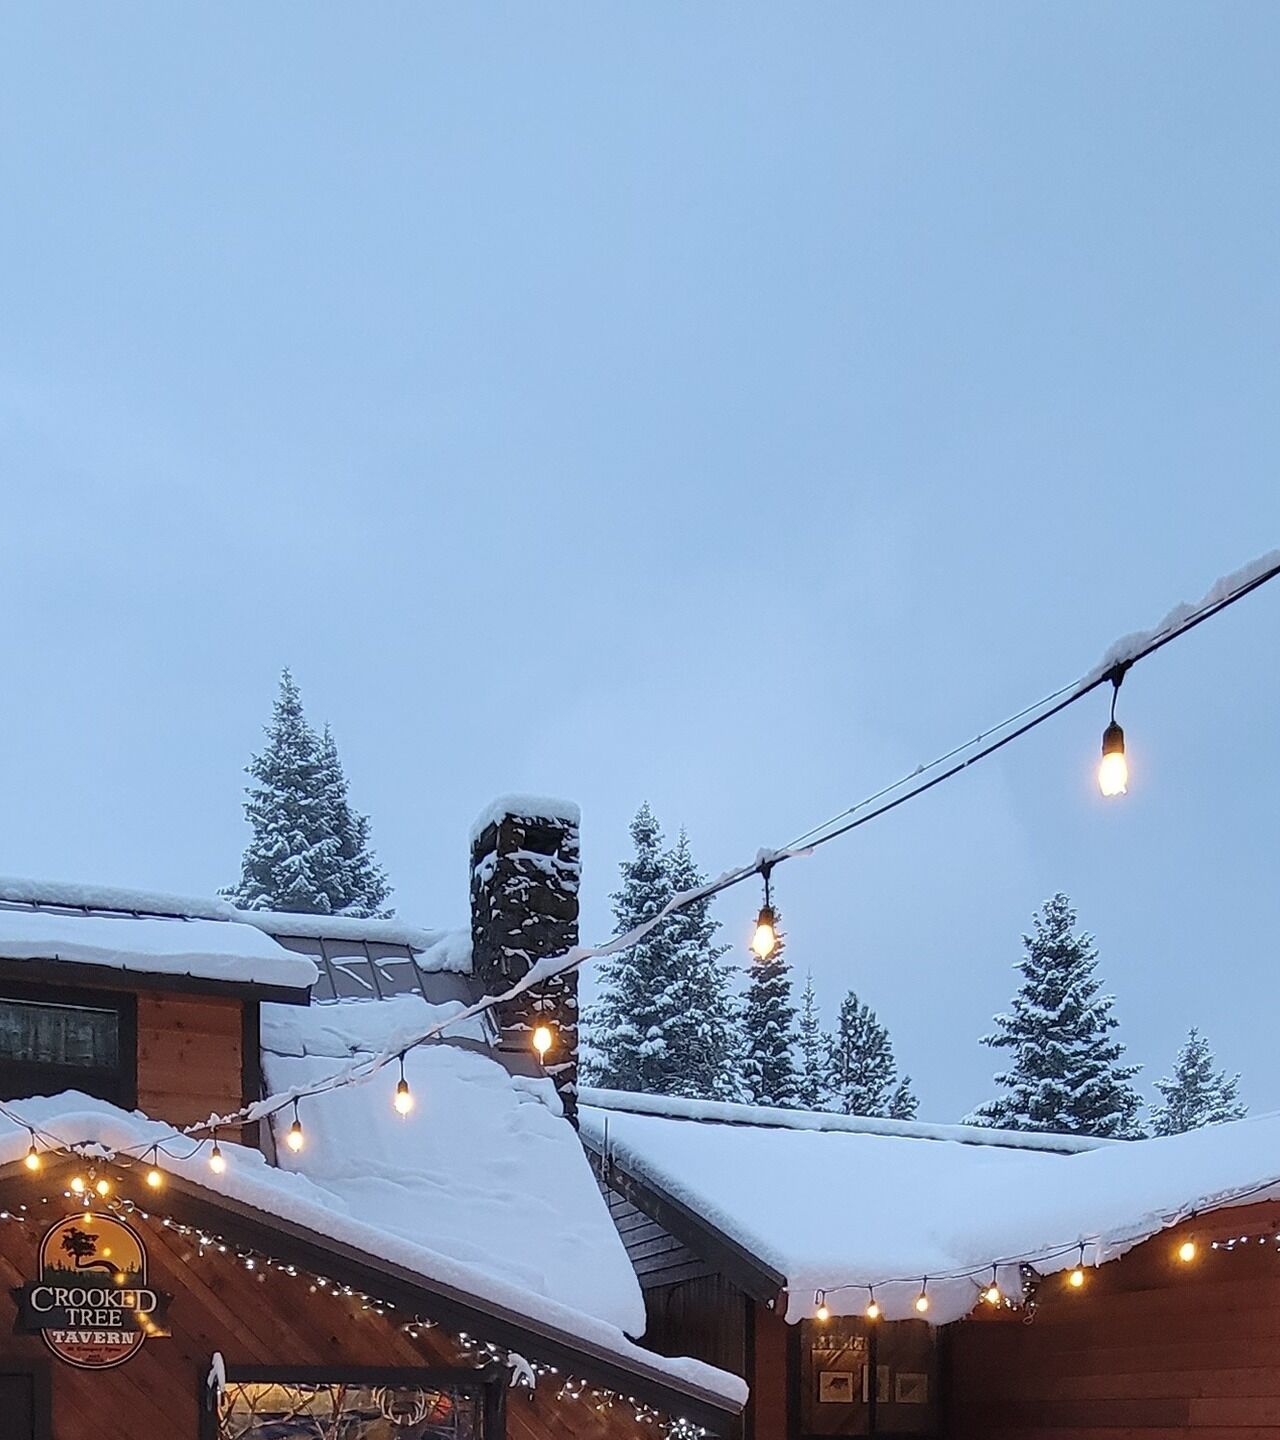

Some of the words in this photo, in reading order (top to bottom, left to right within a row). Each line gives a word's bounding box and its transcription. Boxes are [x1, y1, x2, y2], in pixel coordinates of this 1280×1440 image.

[31, 1286, 157, 1313] CROOKED
[65, 1308, 122, 1327] TREE
[52, 1330, 135, 1344] TAVERN
